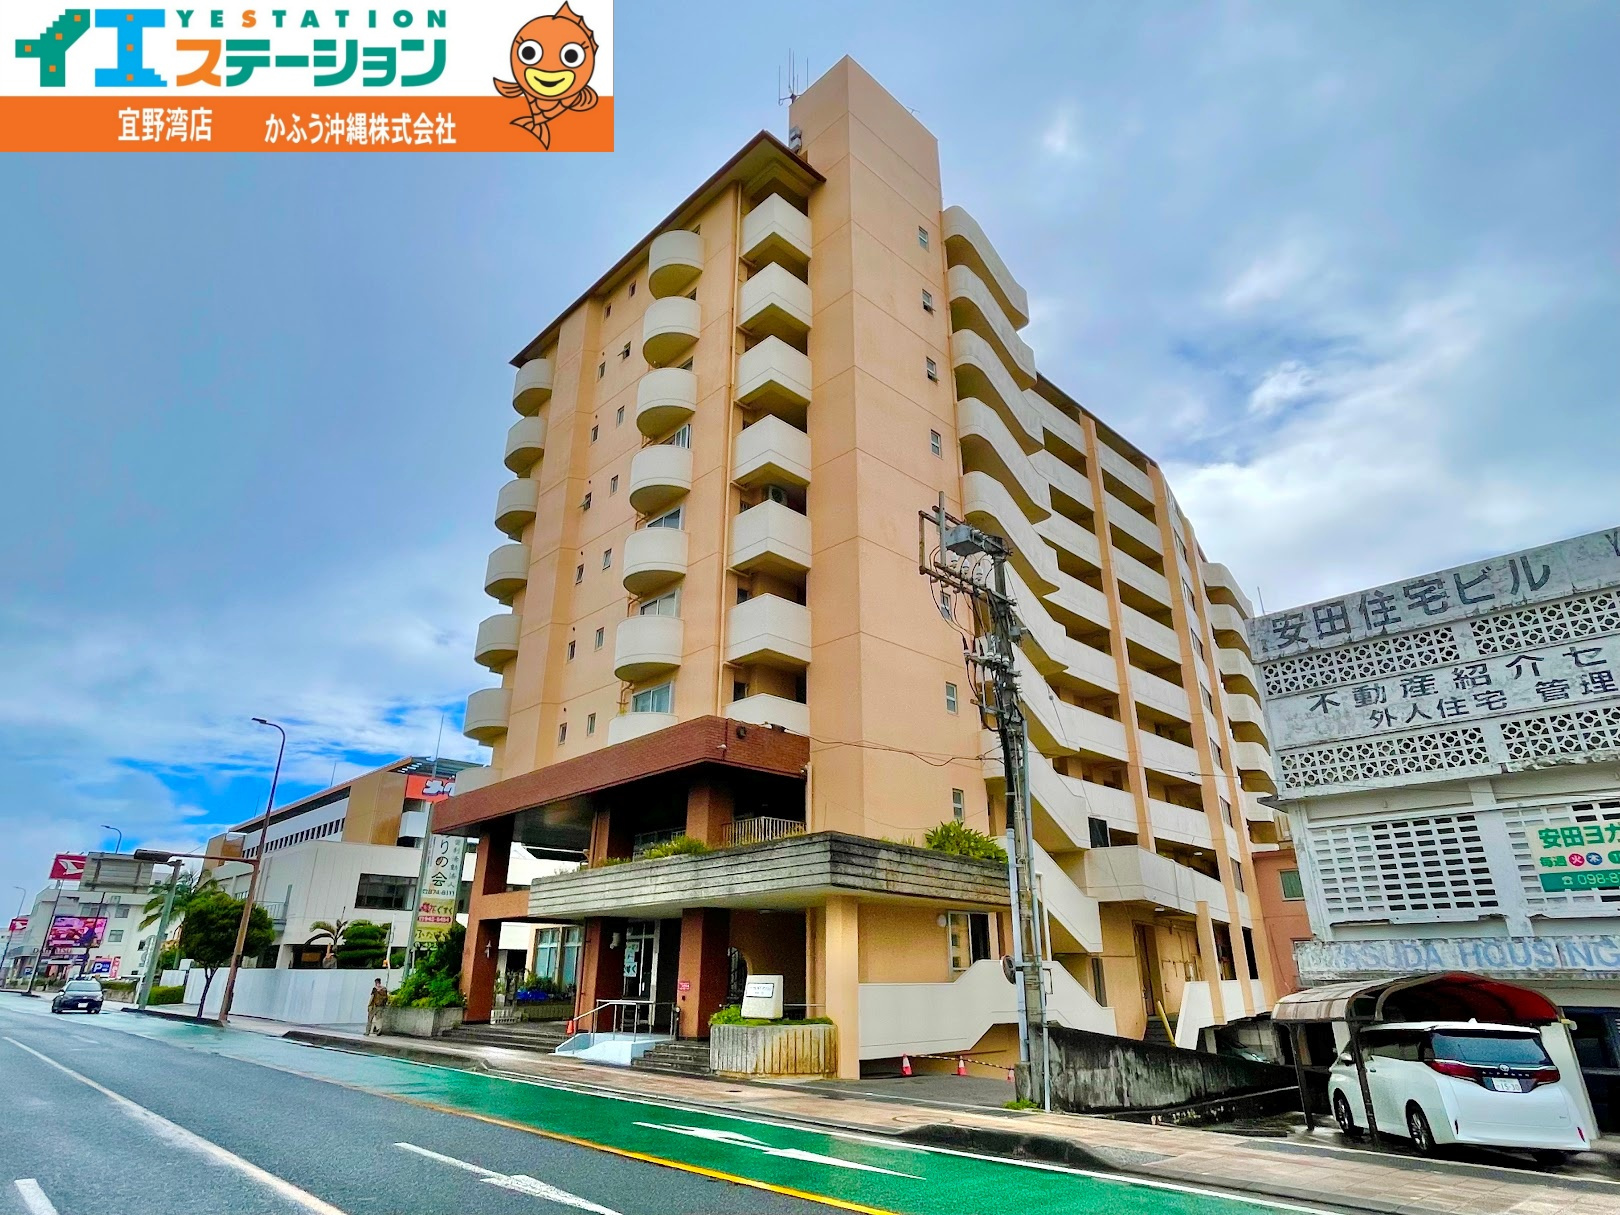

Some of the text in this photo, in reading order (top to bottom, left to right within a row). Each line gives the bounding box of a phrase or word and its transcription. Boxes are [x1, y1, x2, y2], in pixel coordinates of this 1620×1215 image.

[1271, 555, 1551, 648] 安田住宅ビル
[1369, 669, 1618, 729] 外人住宅 管理
[431, 835, 449, 887] りの会
